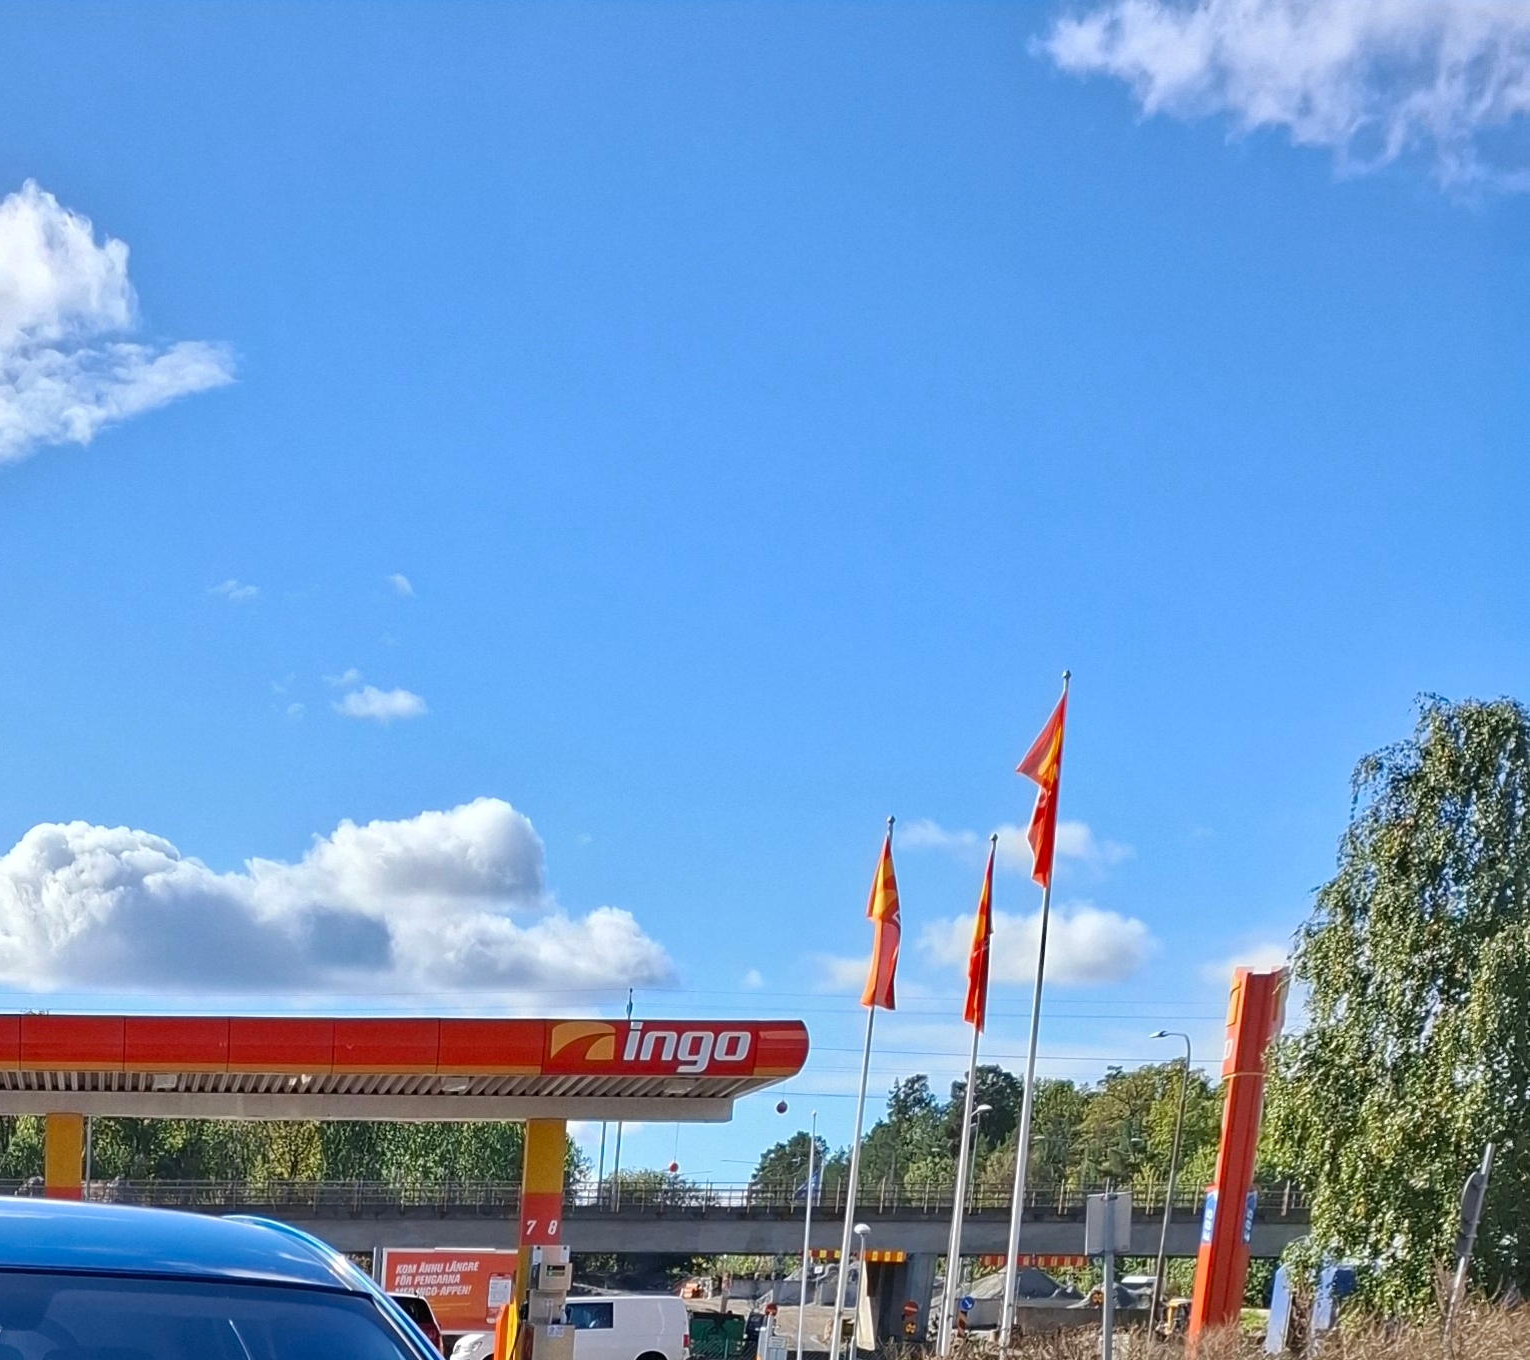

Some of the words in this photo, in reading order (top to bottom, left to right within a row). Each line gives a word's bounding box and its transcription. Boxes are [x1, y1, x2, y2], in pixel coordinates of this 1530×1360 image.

[623, 1021, 751, 1073] ingo
[526, 1220, 537, 1235] 7
[547, 1220, 558, 1235] 8
[395, 1264, 417, 1274] KOM
[418, 1261, 444, 1273] ÄNNU
[445, 1260, 479, 1271] LÄNGRE
[395, 1275, 412, 1286] FÖR
[414, 1274, 460, 1285] PENGARNA
